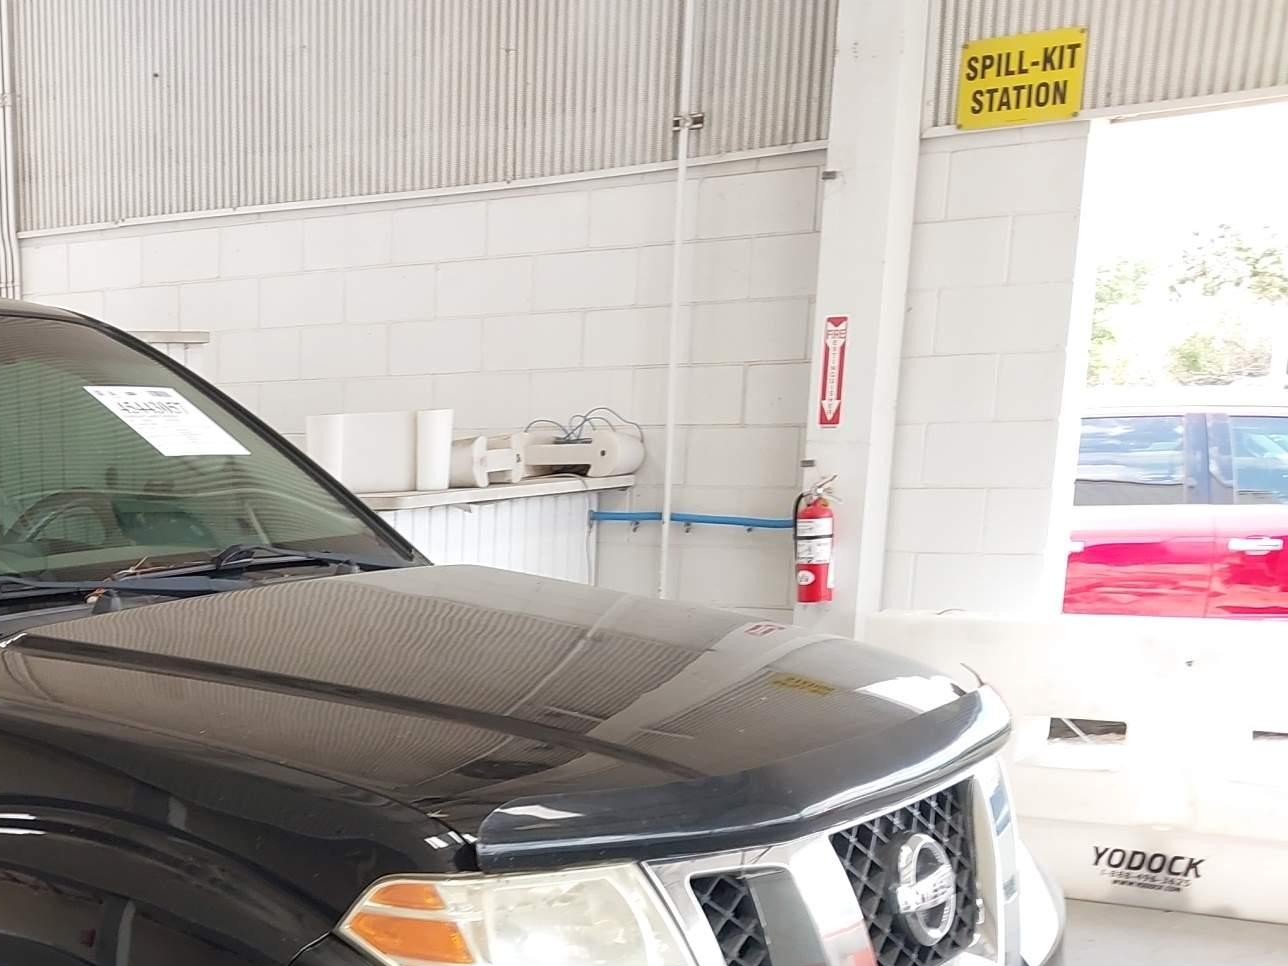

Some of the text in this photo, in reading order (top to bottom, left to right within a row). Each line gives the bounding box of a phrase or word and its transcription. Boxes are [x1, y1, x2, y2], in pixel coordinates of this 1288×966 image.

[965, 43, 1082, 81] SPILL-KIT
[970, 79, 1069, 115] STATION
[1092, 845, 1207, 879] YODOCK
